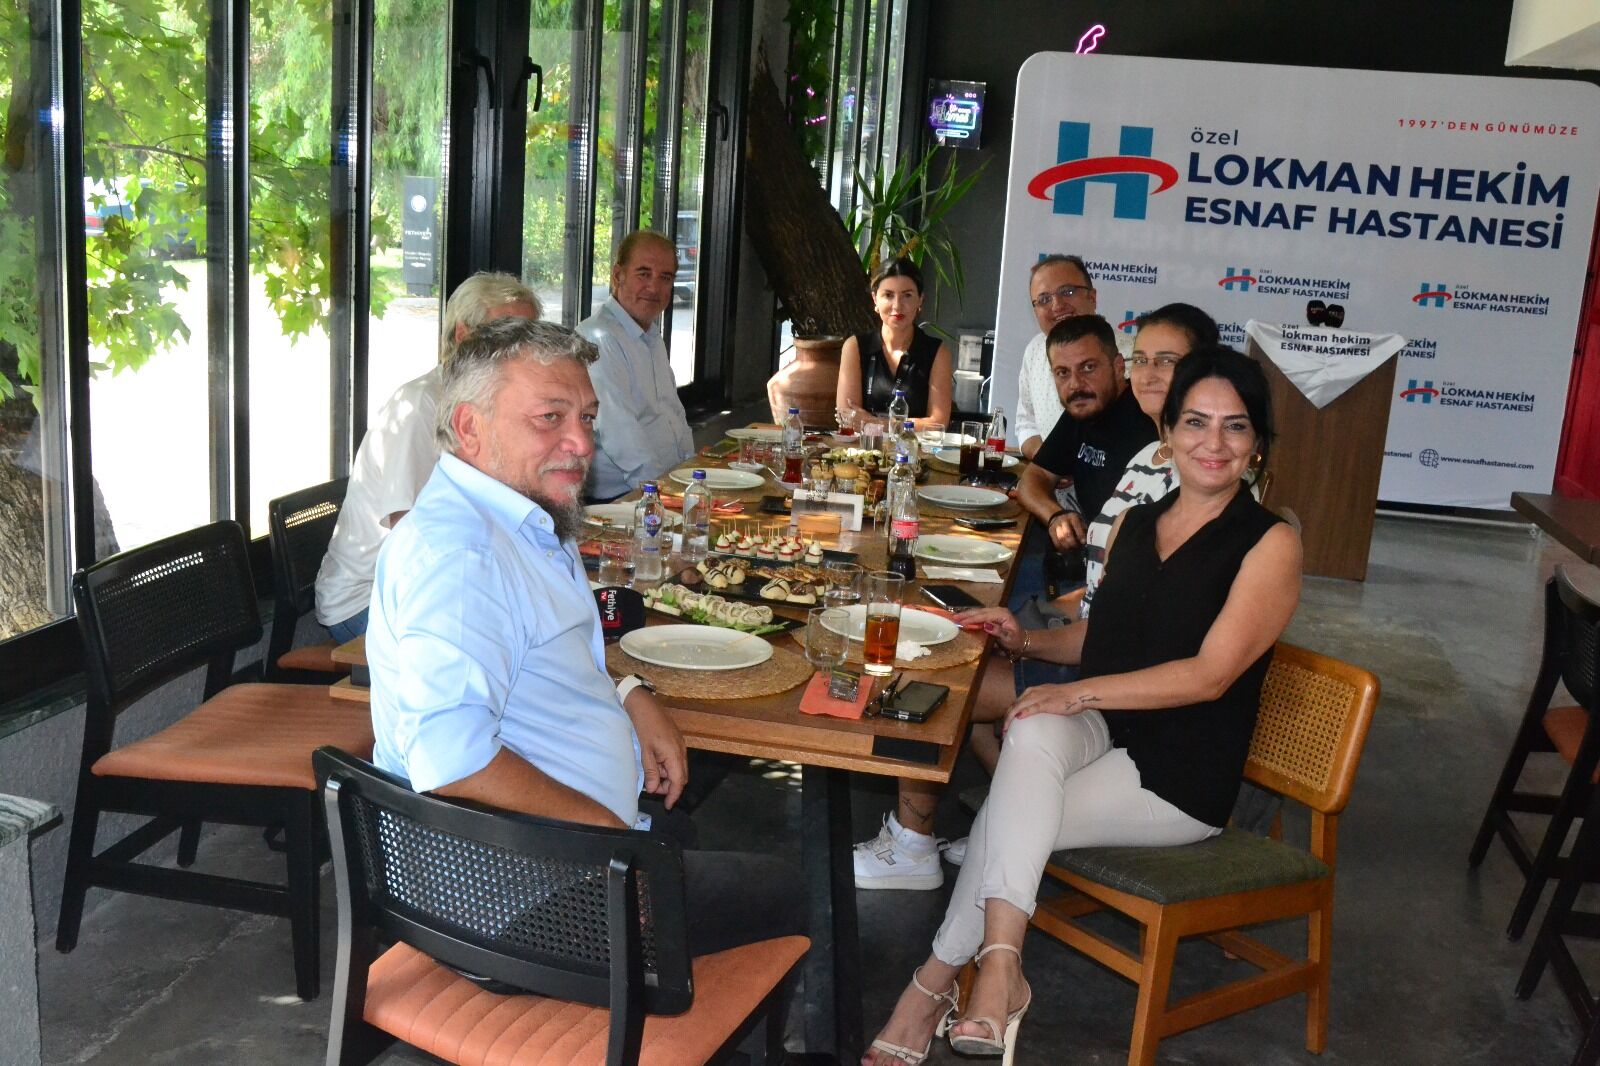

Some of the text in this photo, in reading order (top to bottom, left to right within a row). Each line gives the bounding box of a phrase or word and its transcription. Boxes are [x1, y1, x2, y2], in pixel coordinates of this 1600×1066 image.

[1485, 121, 1578, 136] GÜNÜMÜZE
[1190, 127, 1219, 146] özel
[1187, 151, 1570, 208] LOKMAN HEKİM
[1184, 196, 1565, 250] ESNAF HASTANESİ
[1085, 261, 1158, 275] KMAN HEKİM
[1102, 273, 1157, 285] HASTANESİ
[1258, 274, 1350, 290] LOKMAN HEKİM
[1257, 285, 1350, 300] ESNAF HASTANESİ
[1454, 290, 1550, 306] LOKMAN HEKİM
[1453, 301, 1548, 315] ESNAF HASTANESİ
[1281, 329, 1371, 346] lokman hekim
[1407, 338, 1437, 349] EKİM
[1280, 342, 1371, 357] ESNAF HASTANESİ
[1400, 348, 1436, 359] TANESİ
[1441, 387, 1535, 403] LOKMAN HEKİM
[1440, 397, 1534, 412] ESNAF HASTANESİ
[1440, 456, 1535, 470] www.esnafhastanesi.com
[601, 591, 607, 600] TV
[605, 589, 617, 621] Fethiye
